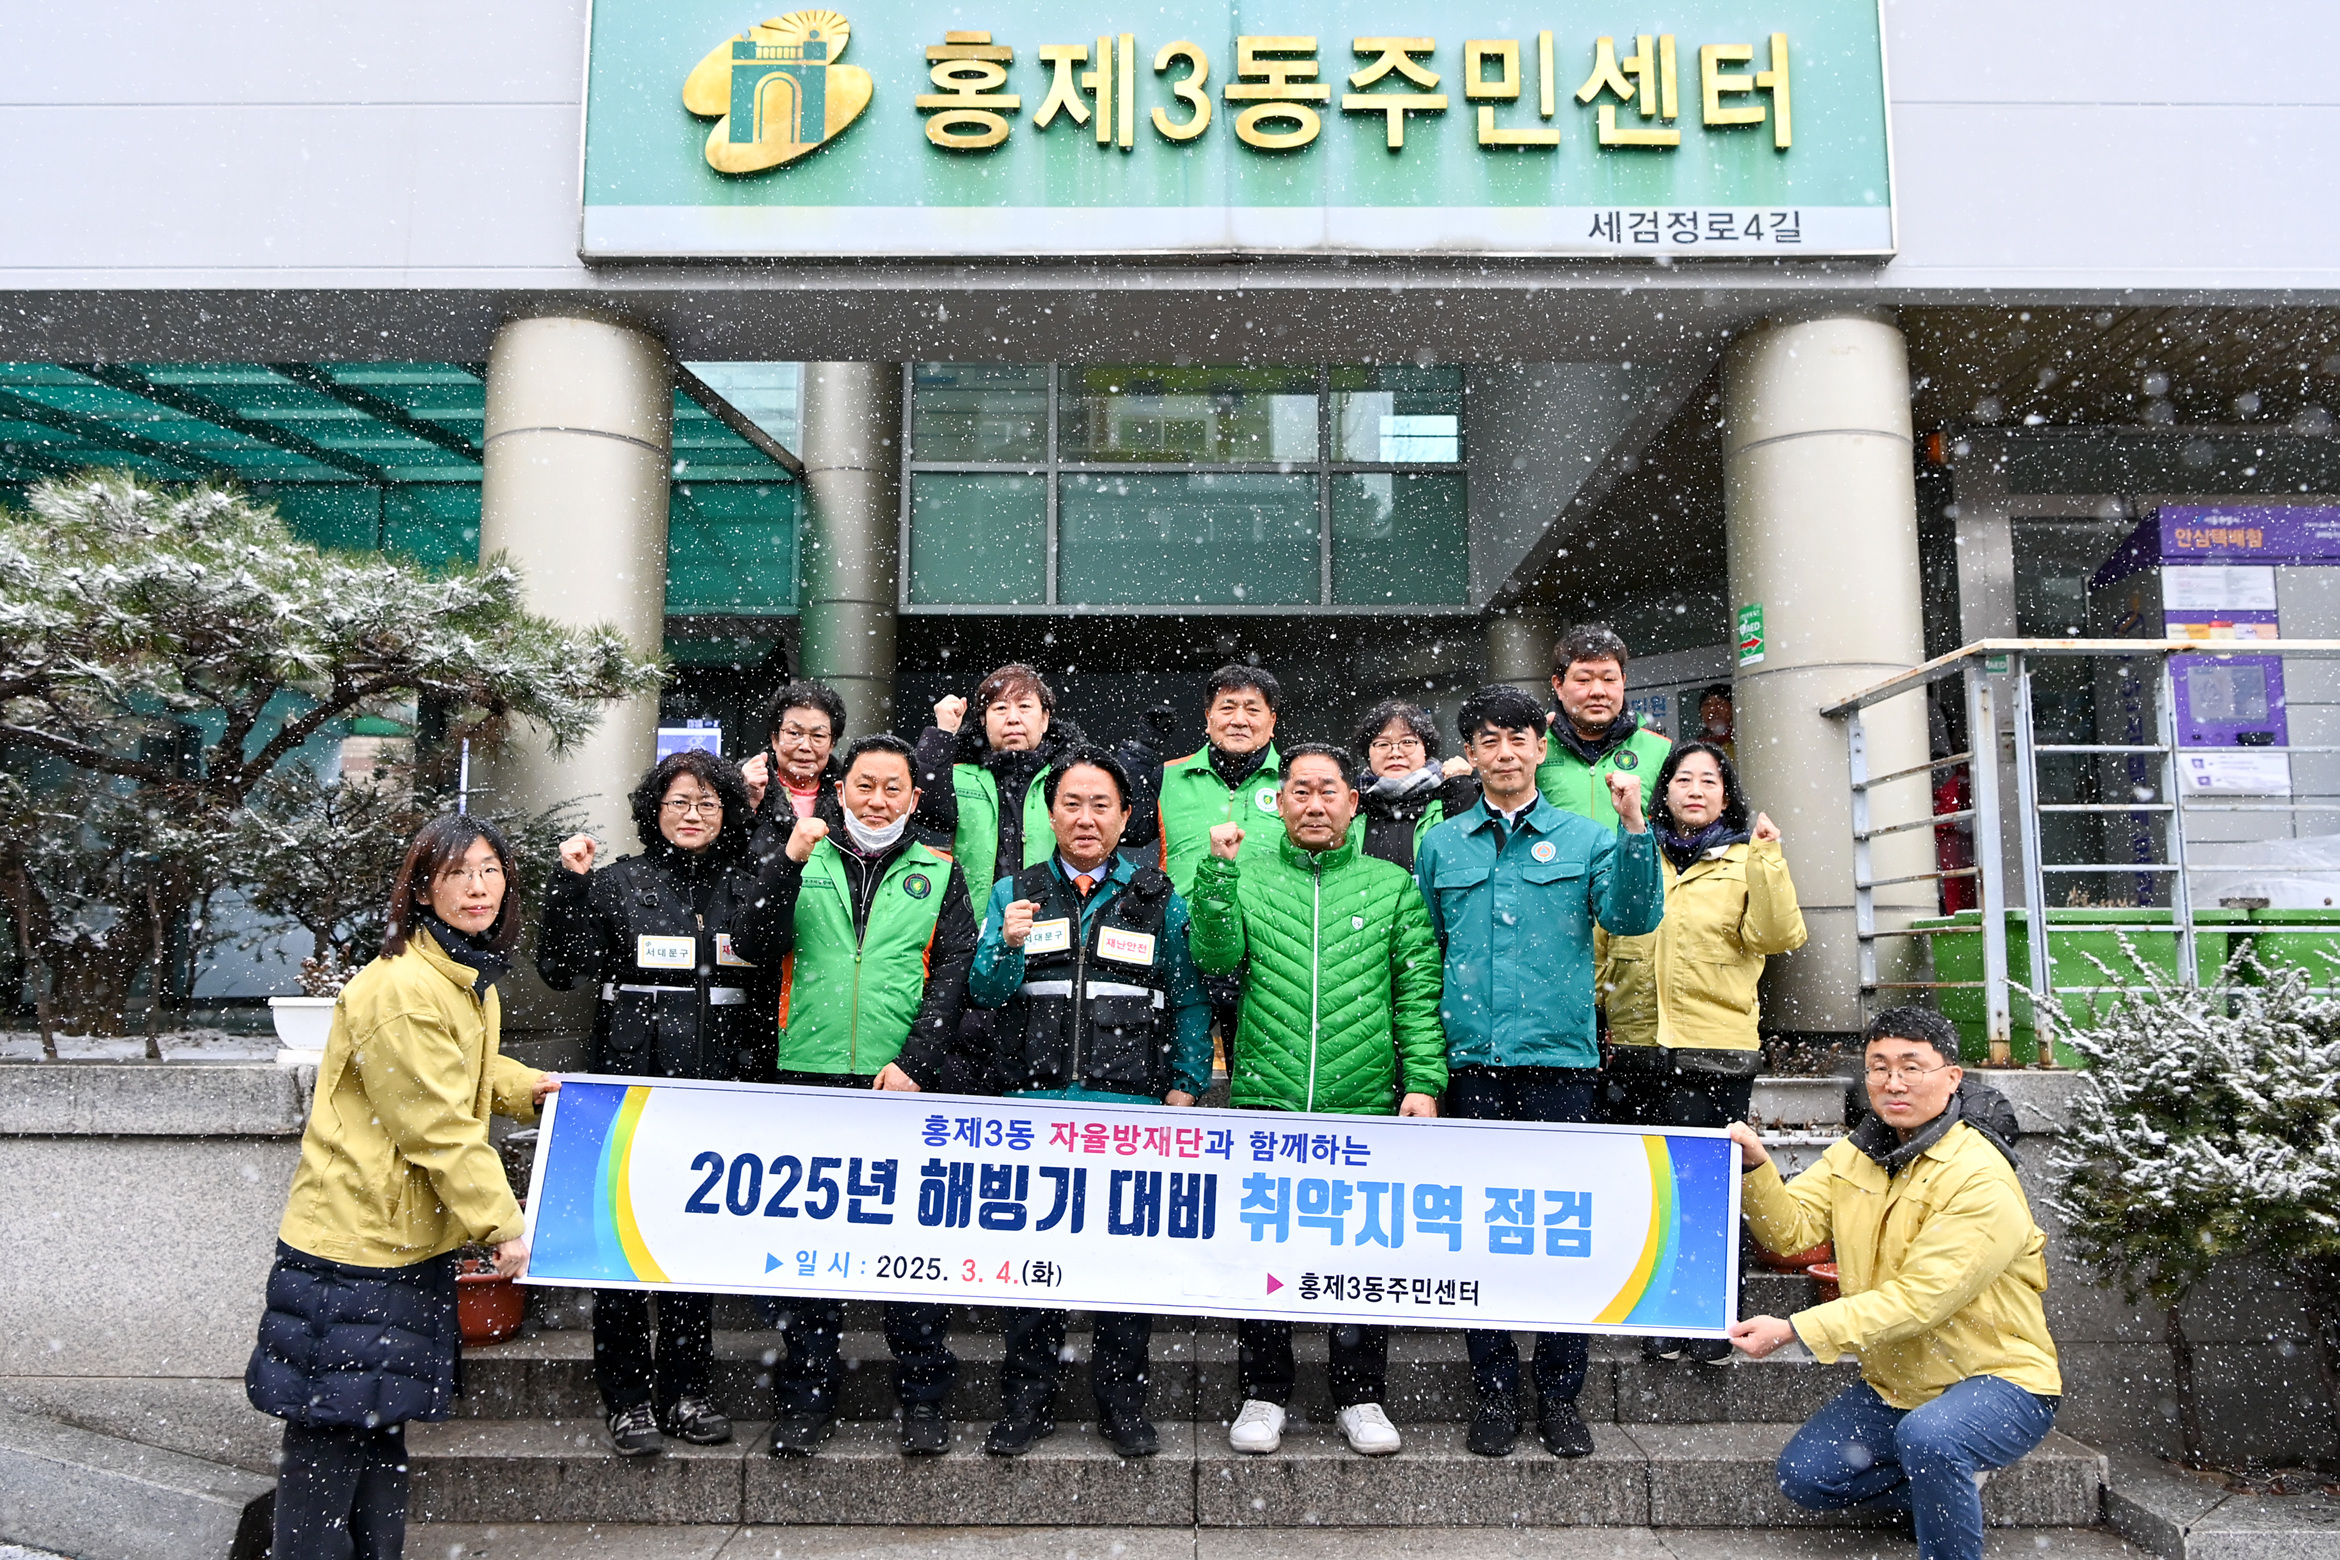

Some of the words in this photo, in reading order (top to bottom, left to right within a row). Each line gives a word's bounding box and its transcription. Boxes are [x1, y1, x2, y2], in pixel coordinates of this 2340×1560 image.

[914, 30, 1792, 150] 홍제3동주민센터
[1588, 210, 1802, 245] 세검정로4길
[2174, 527, 2264, 548] 안심택배함
[645, 948, 689, 958] 서대문구
[1105, 937, 1148, 955] 재난안전
[921, 1114, 1035, 1151] 홍제3동
[1049, 1120, 1234, 1161] 자율방재단과
[1249, 1130, 1371, 1167] 함께하는
[684, 1150, 899, 1225] 2025년
[917, 1157, 1088, 1235] 해빙기
[1107, 1168, 1218, 1240] 대비
[1239, 1171, 1463, 1252] 취약지역
[1484, 1187, 1593, 1259] 점검
[876, 1254, 949, 1282] 2025.
[961, 1258, 984, 1284] 3.
[1298, 1271, 1480, 1307] 홍제3동주민센터
